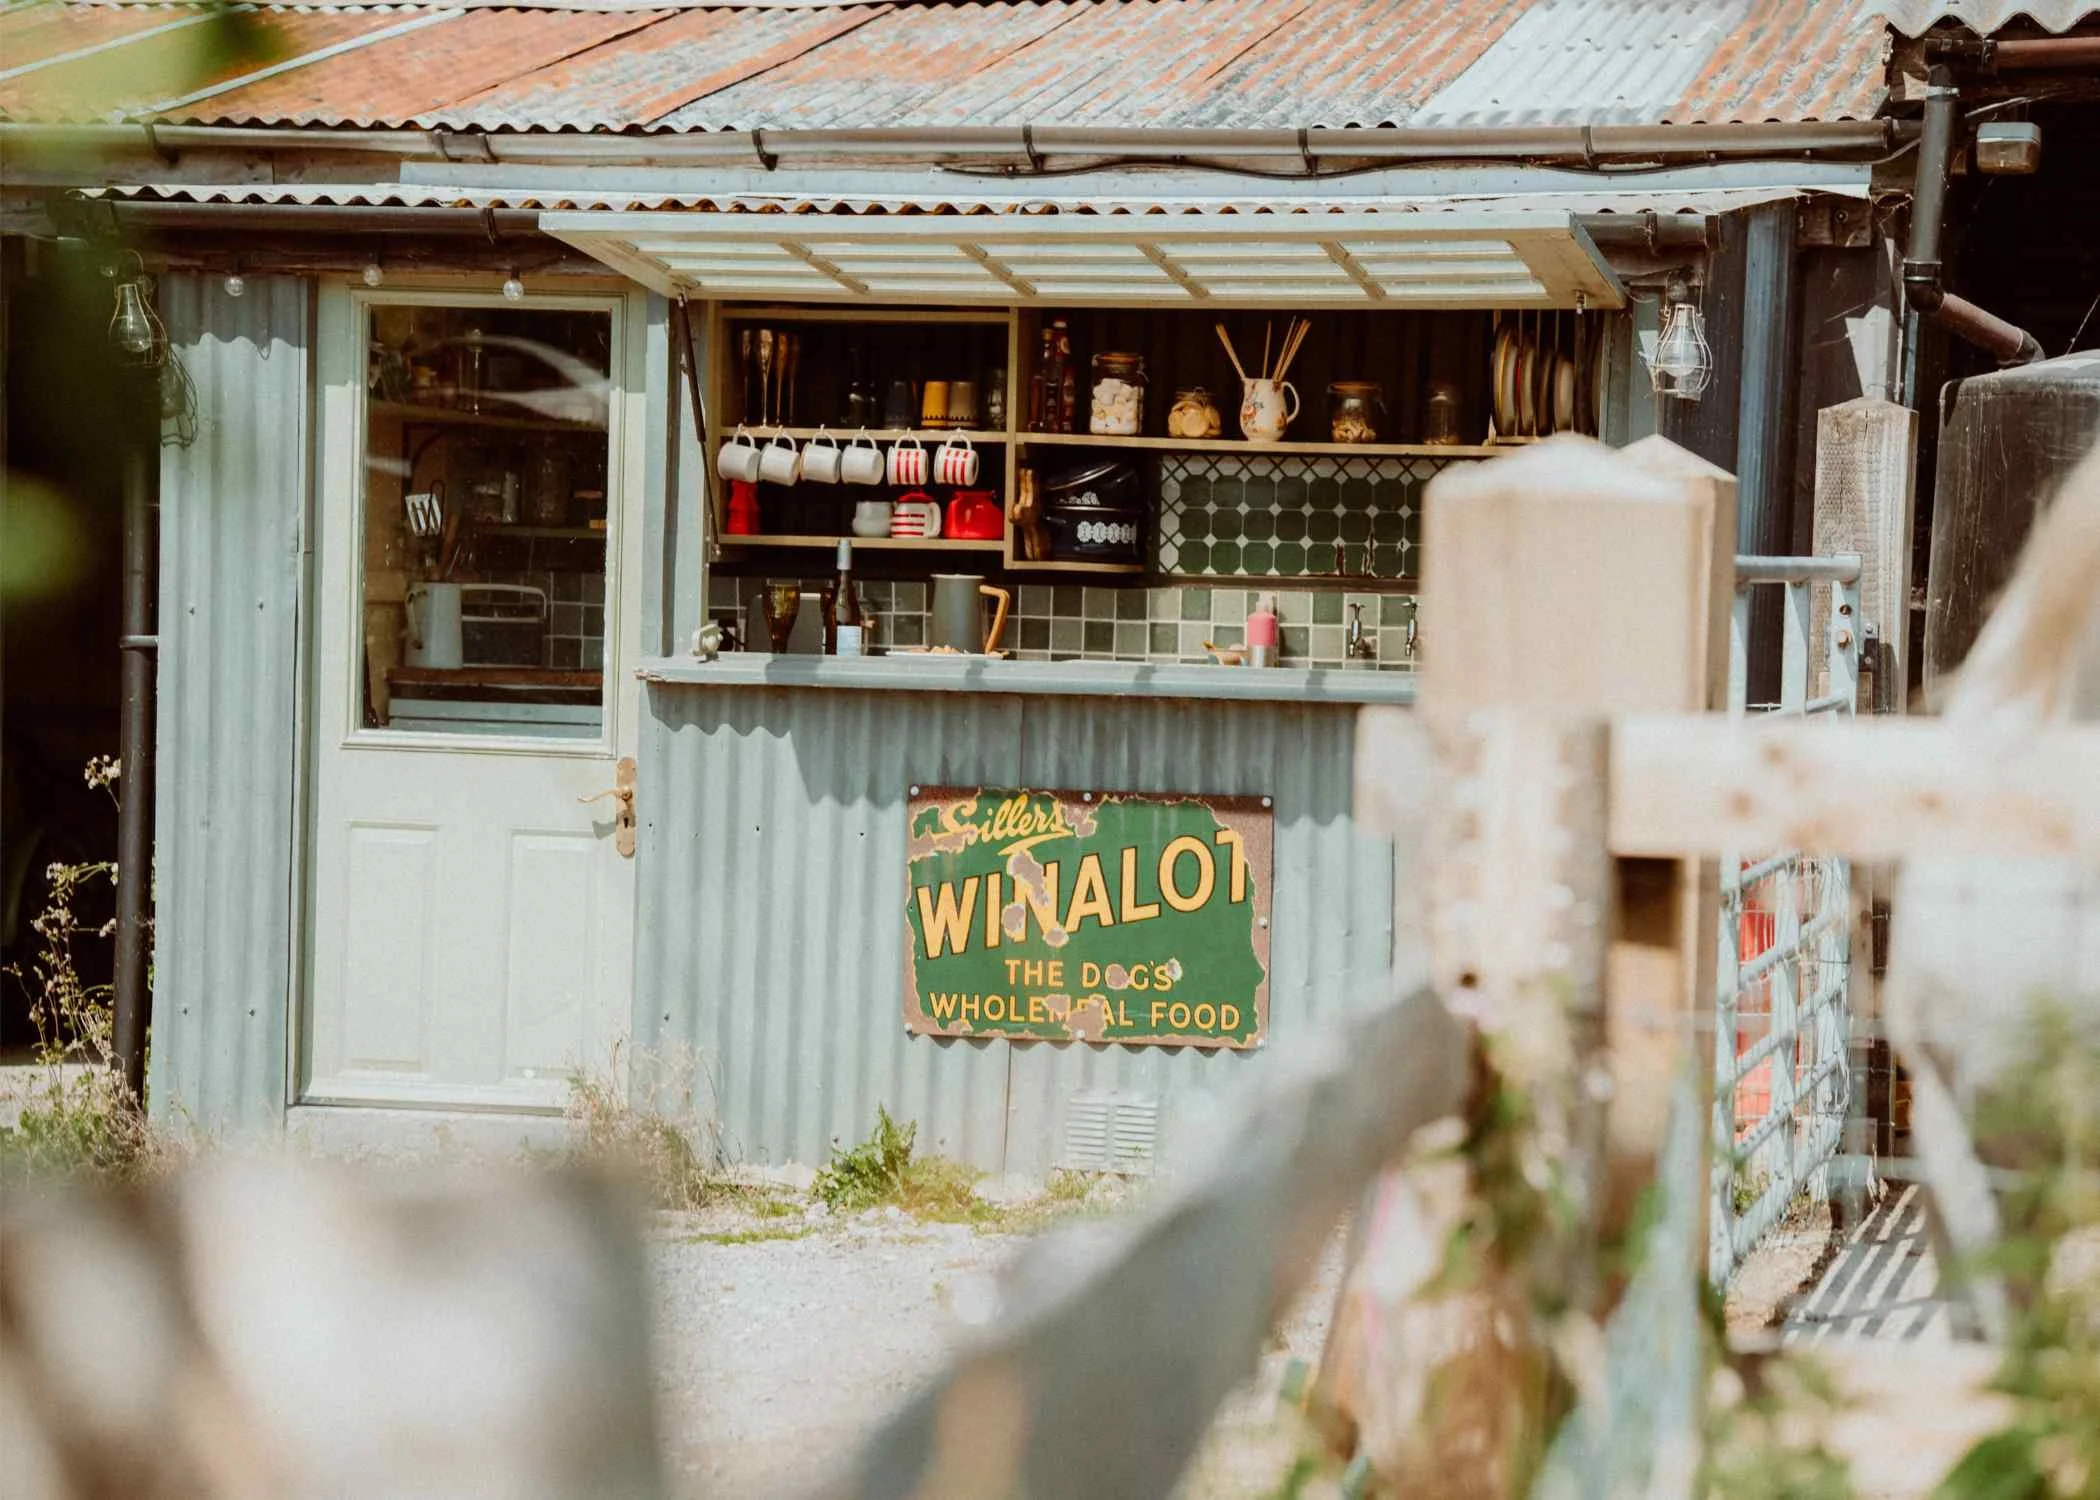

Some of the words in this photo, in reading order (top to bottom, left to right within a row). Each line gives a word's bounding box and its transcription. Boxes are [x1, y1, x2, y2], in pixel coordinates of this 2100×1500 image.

[915, 828, 1247, 960] WINALOT
[1004, 959, 1064, 988] THE
[1151, 1001, 1241, 1031] FOOD
